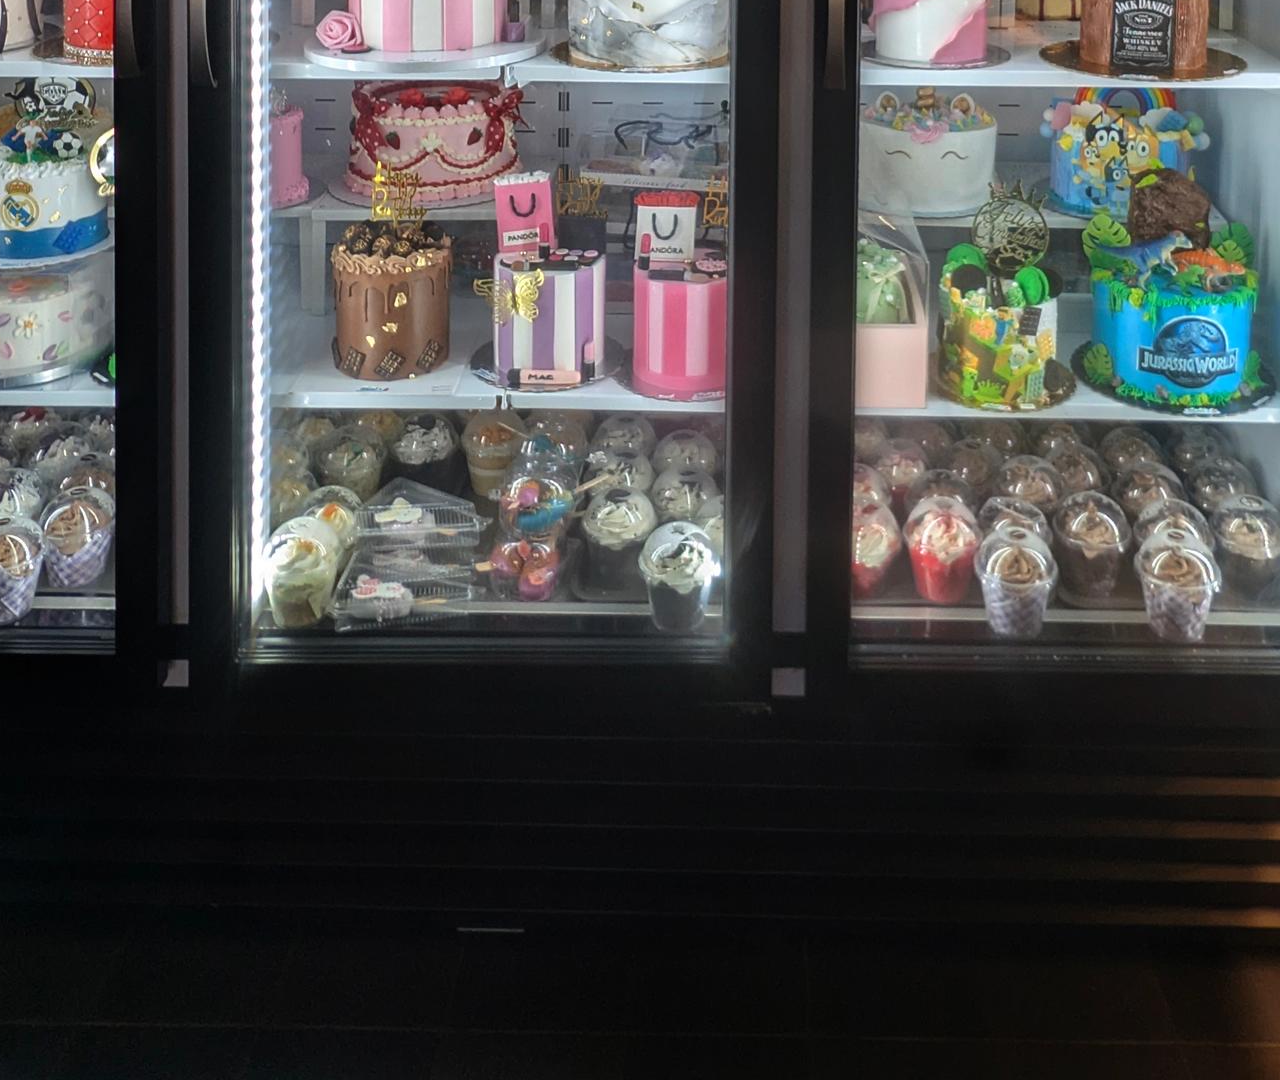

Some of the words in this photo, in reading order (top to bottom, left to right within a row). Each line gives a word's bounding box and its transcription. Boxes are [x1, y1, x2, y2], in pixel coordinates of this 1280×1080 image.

[1115, 0, 1138, 14] JACK
[507, 231, 539, 242] PANDOR
[650, 245, 684, 254] ANDORA
[1141, 351, 1195, 372] JURASSIC
[1195, 355, 1236, 374] WORLD
